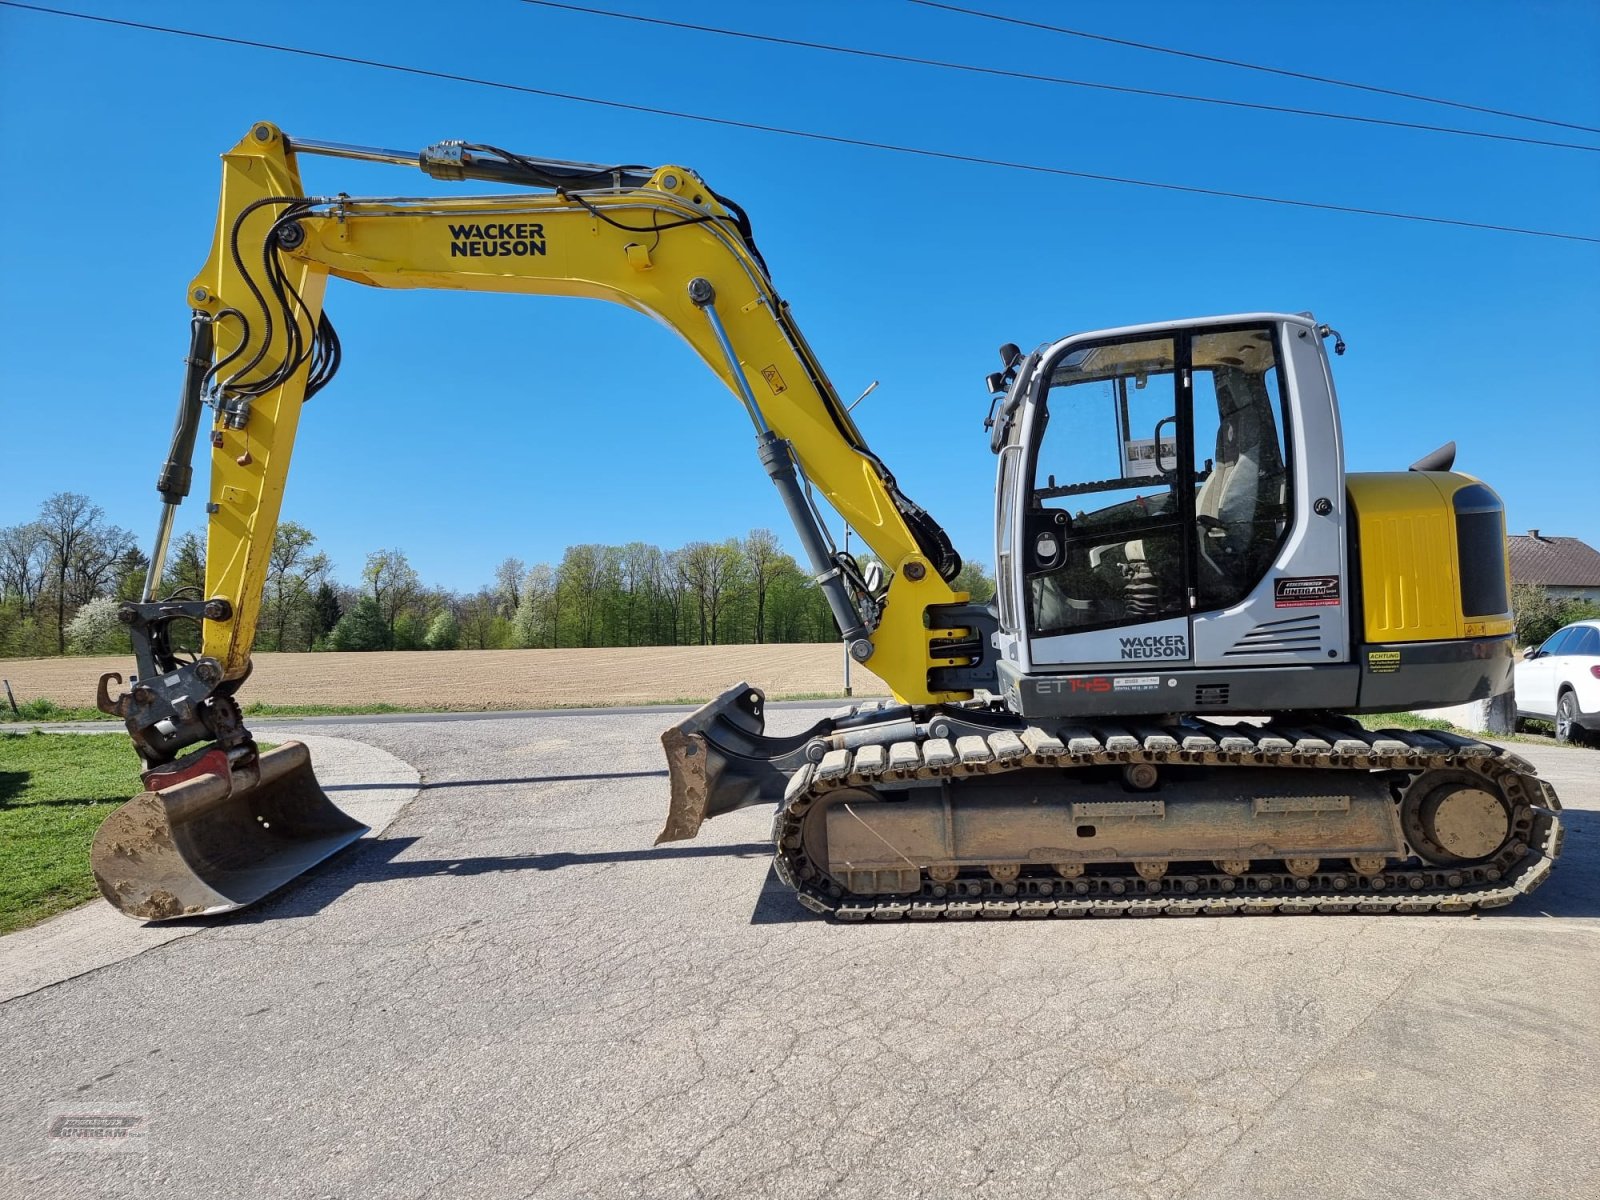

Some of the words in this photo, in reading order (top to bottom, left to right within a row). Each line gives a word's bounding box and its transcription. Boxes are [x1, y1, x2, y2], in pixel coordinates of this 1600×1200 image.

[448, 224, 546, 240] WACKER
[451, 240, 546, 257] NEUSON
[1119, 635, 1185, 648] WACKER
[1121, 646, 1186, 659] NEUSON
